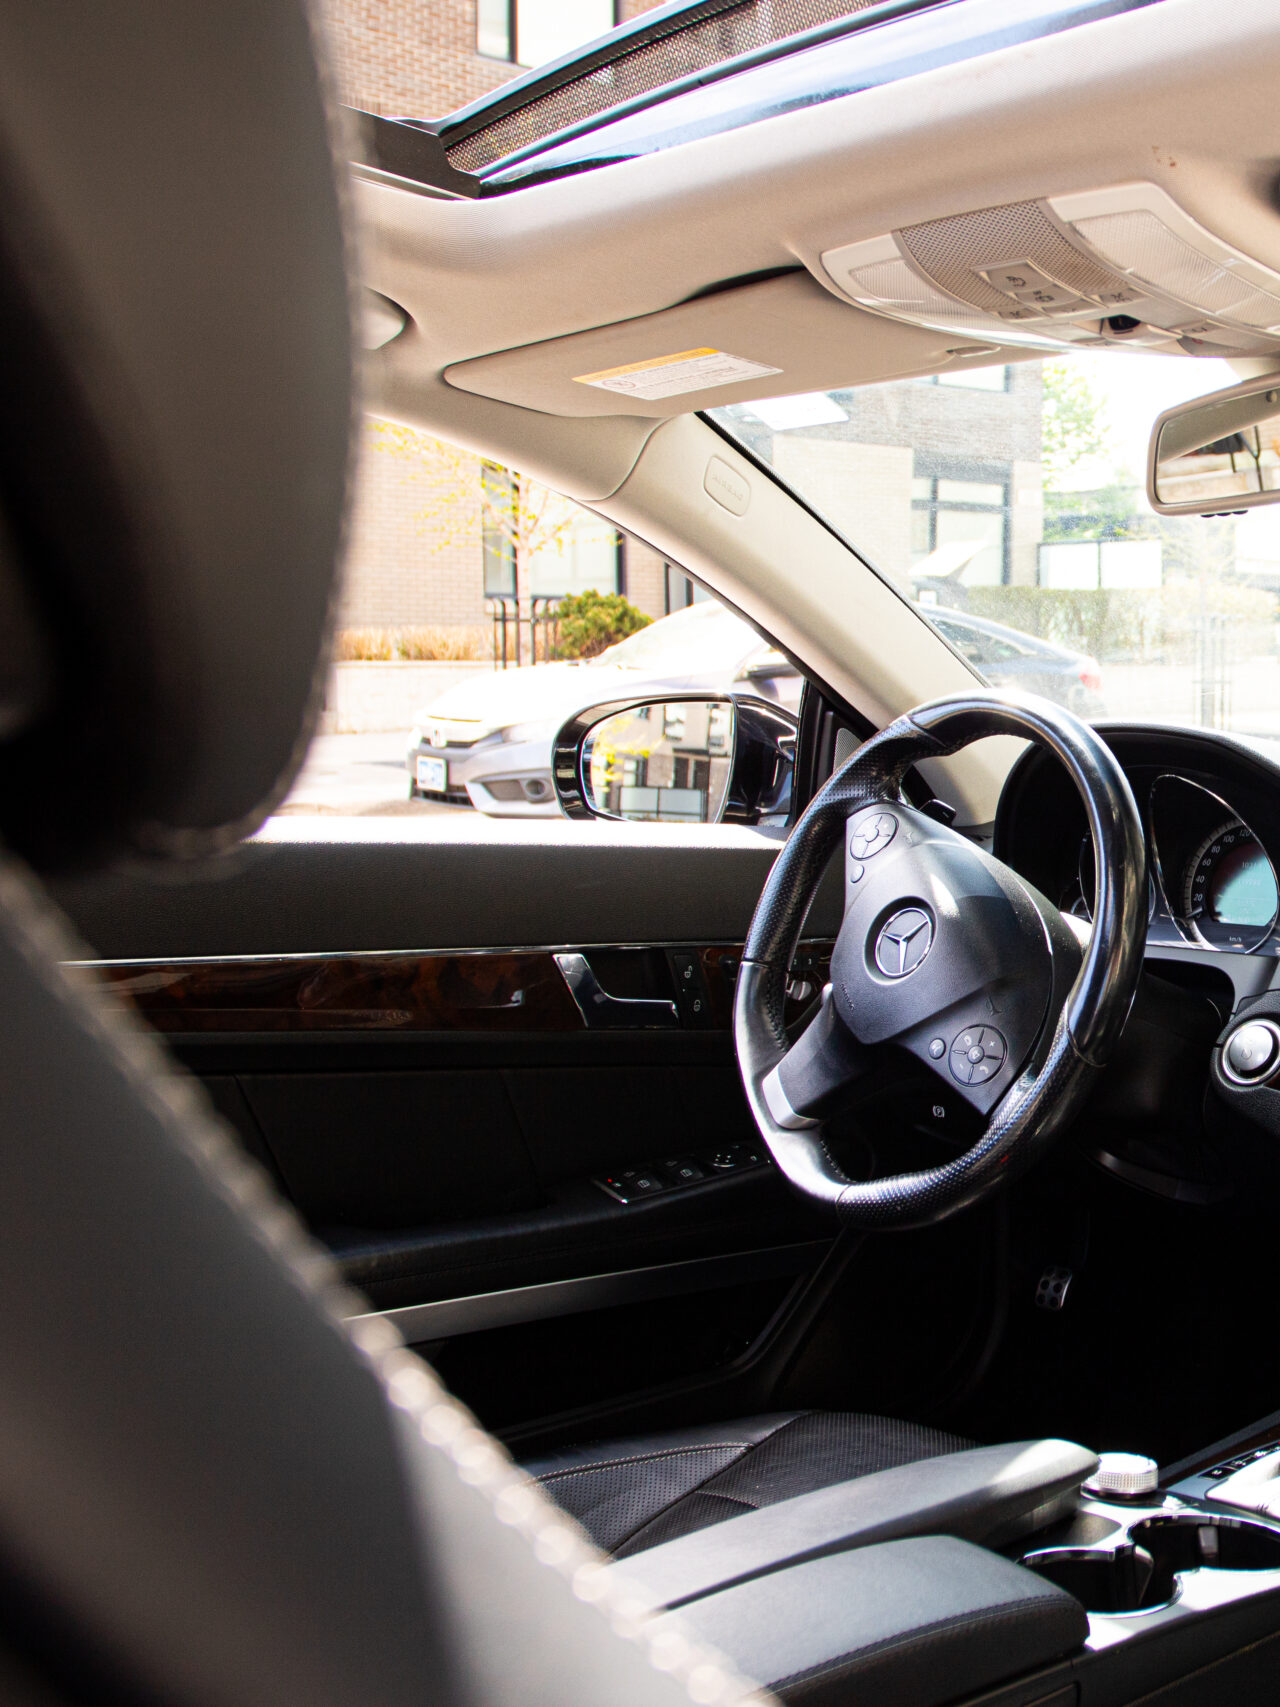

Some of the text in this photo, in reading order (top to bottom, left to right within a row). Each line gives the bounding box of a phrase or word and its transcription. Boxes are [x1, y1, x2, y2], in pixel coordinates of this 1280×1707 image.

[1223, 835, 1235, 843] 100
[1211, 846, 1221, 854] 80
[1202, 858, 1212, 867] 60
[1193, 893, 1203, 902] 20
